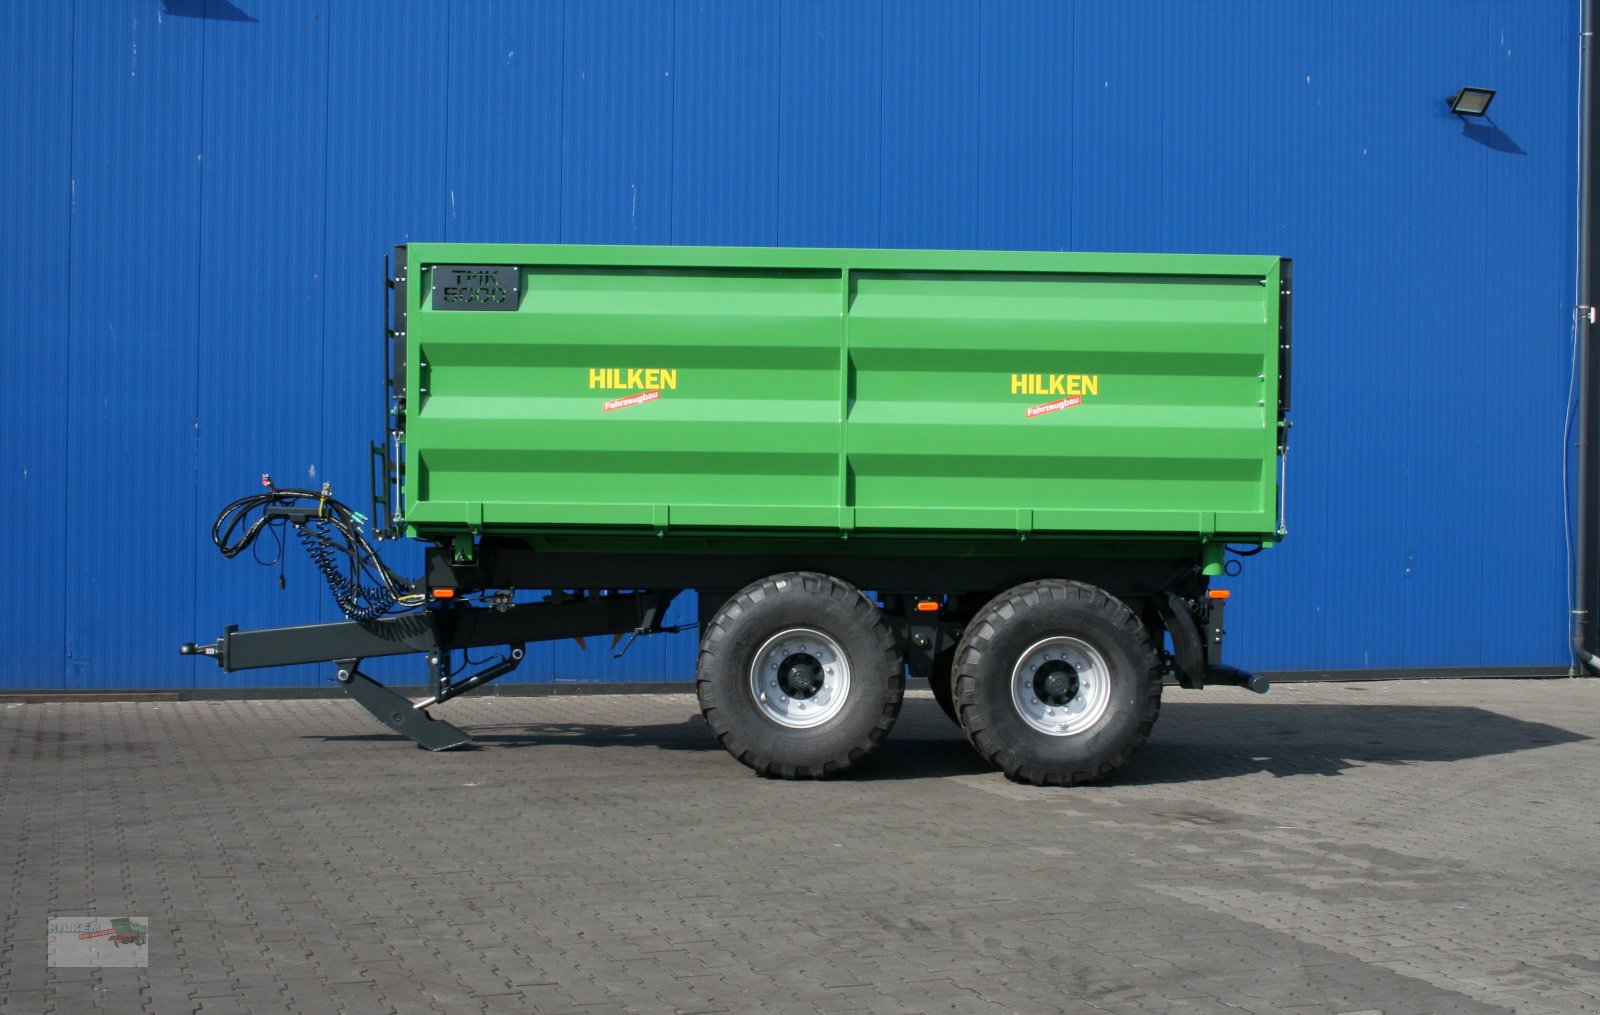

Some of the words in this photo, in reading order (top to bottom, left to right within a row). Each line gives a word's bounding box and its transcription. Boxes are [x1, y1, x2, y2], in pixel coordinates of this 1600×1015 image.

[451, 270, 499, 285] TMK
[589, 368, 677, 390] HILKEN
[1011, 373, 1098, 396] HILKEN
[604, 391, 659, 410] Fahrzeugbau
[1027, 396, 1080, 417] Fahrzeugbau
